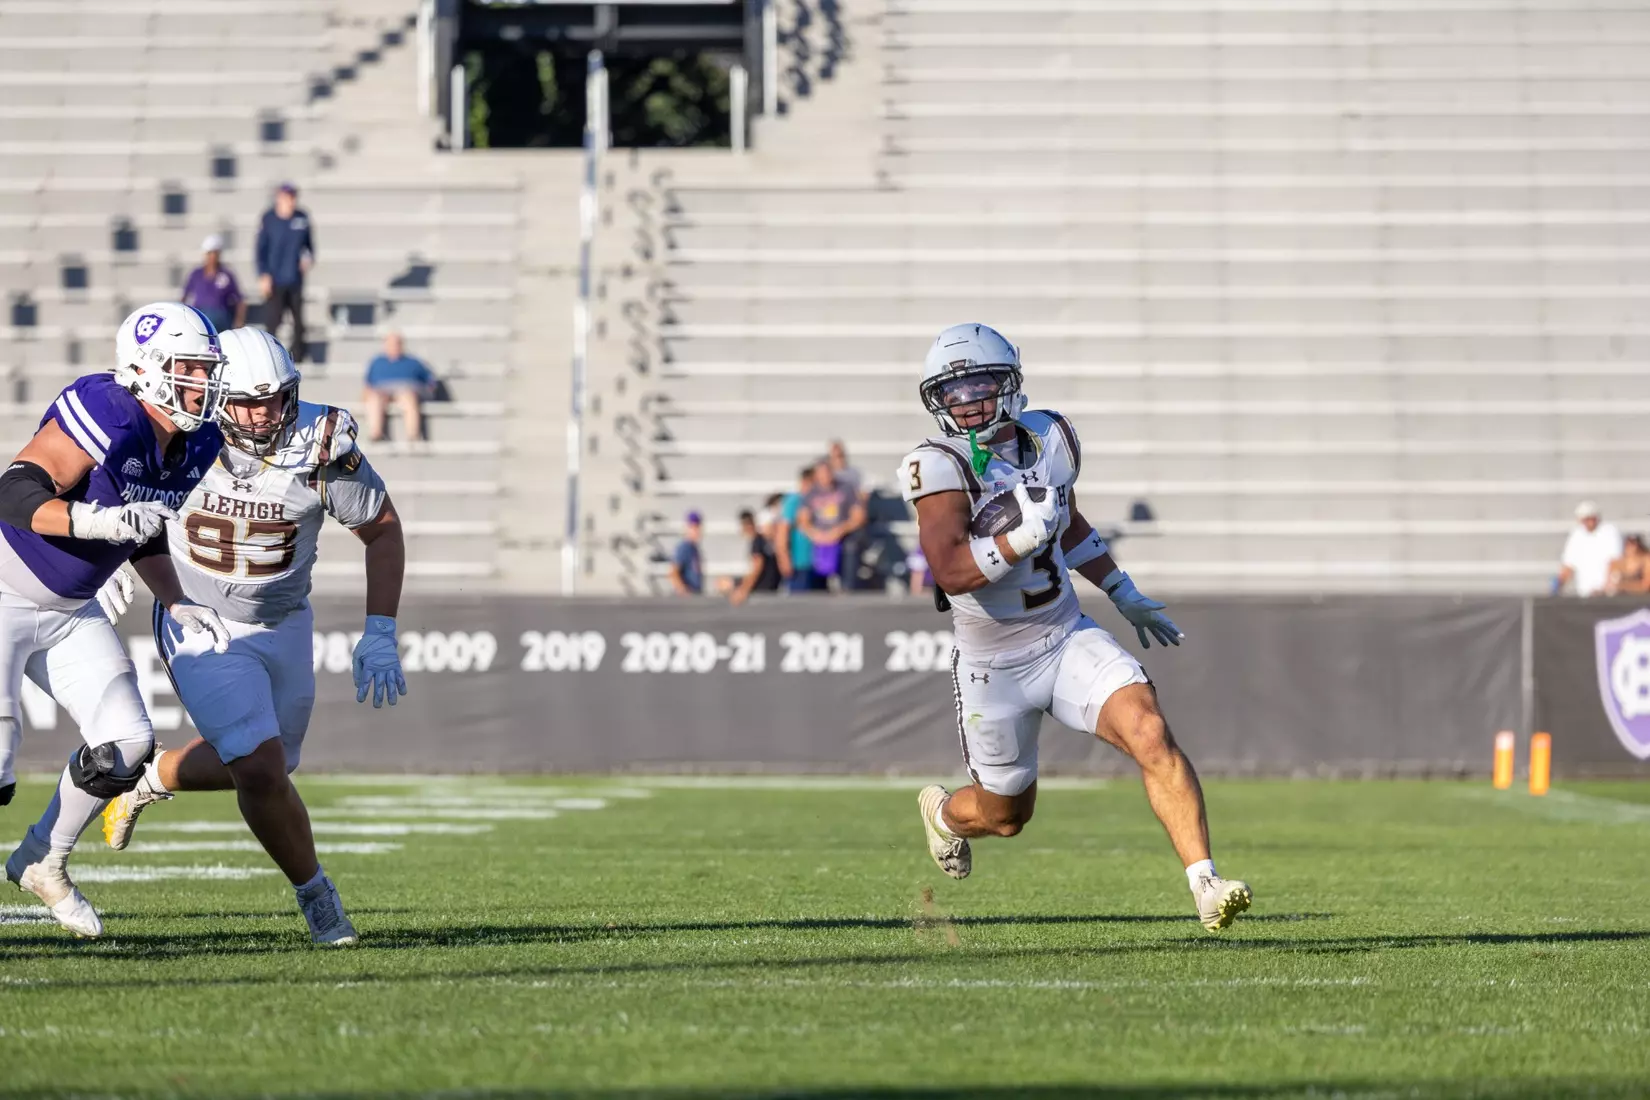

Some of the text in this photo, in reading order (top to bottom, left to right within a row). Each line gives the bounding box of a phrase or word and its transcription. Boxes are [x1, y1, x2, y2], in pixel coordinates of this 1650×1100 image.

[908, 461, 922, 491] 3
[120, 482, 153, 503] HOLY
[202, 492, 286, 520] LEHIGH
[1021, 525, 1062, 610] 3
[399, 630, 498, 673] 2009
[520, 630, 606, 672] 2019
[620, 631, 766, 673] 2020-21
[779, 631, 864, 672] 2021
[884, 630, 953, 672] 202
